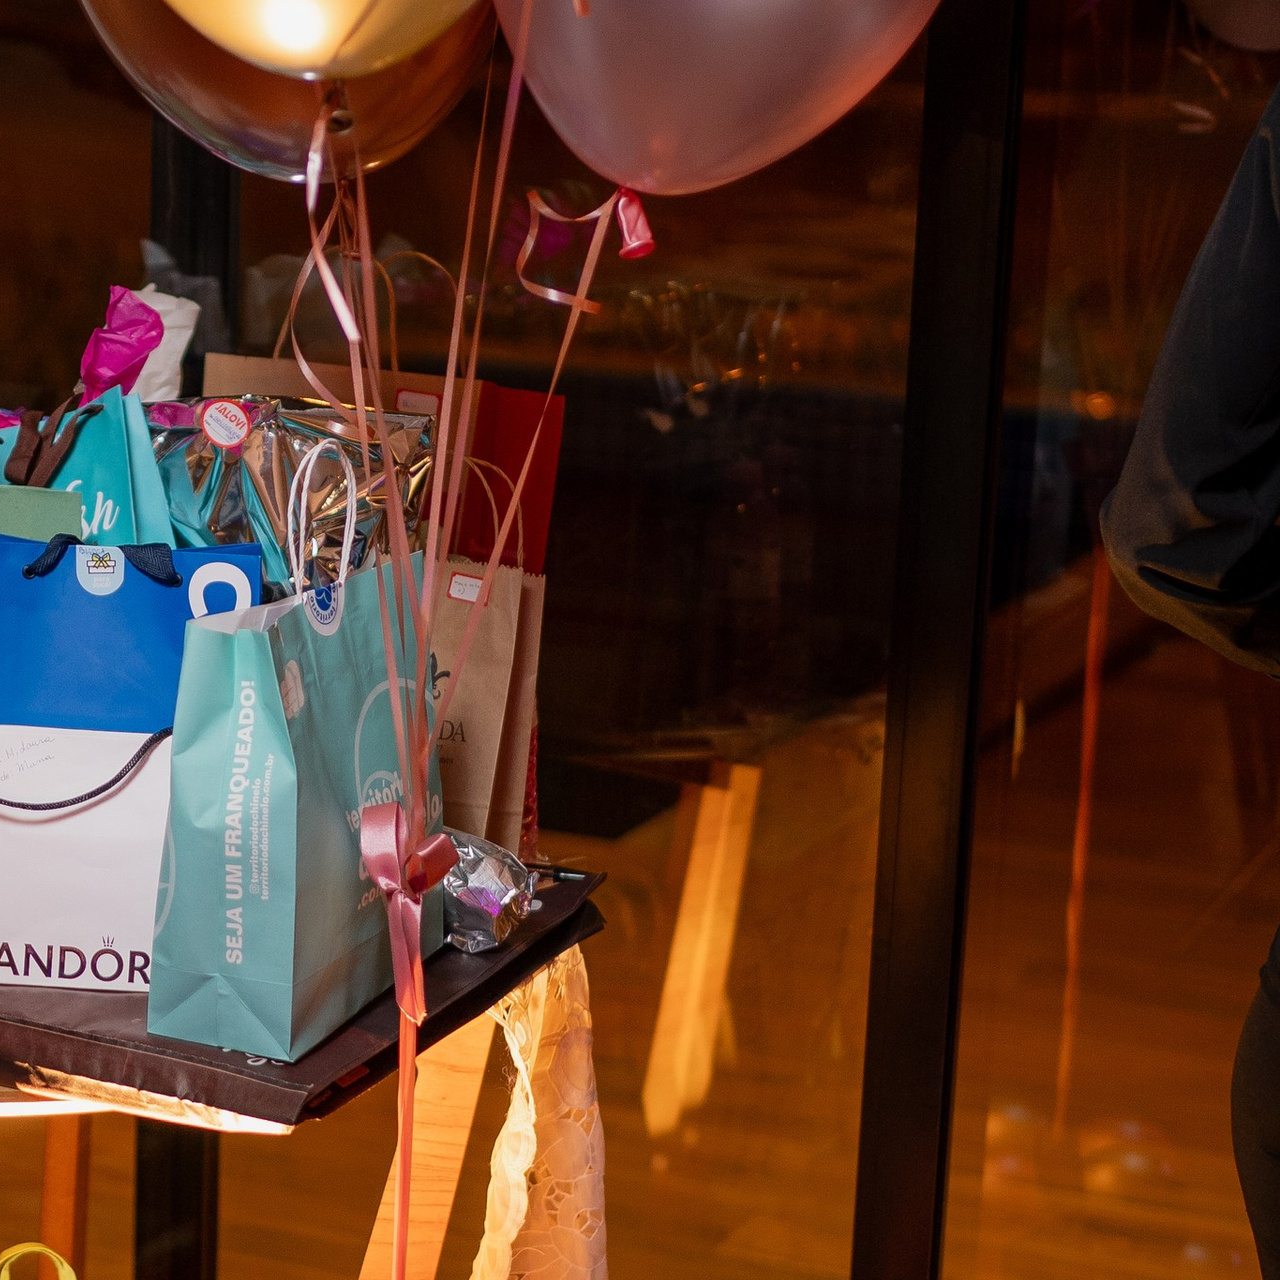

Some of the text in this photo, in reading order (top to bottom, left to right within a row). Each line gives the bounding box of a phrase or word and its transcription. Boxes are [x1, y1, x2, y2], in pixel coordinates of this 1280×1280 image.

[214, 403, 247, 430] JALOVI
[225, 680, 255, 965] SEJA UM FRANQUEADO!
[261, 753, 275, 901] territoriodochinelo.com.br
